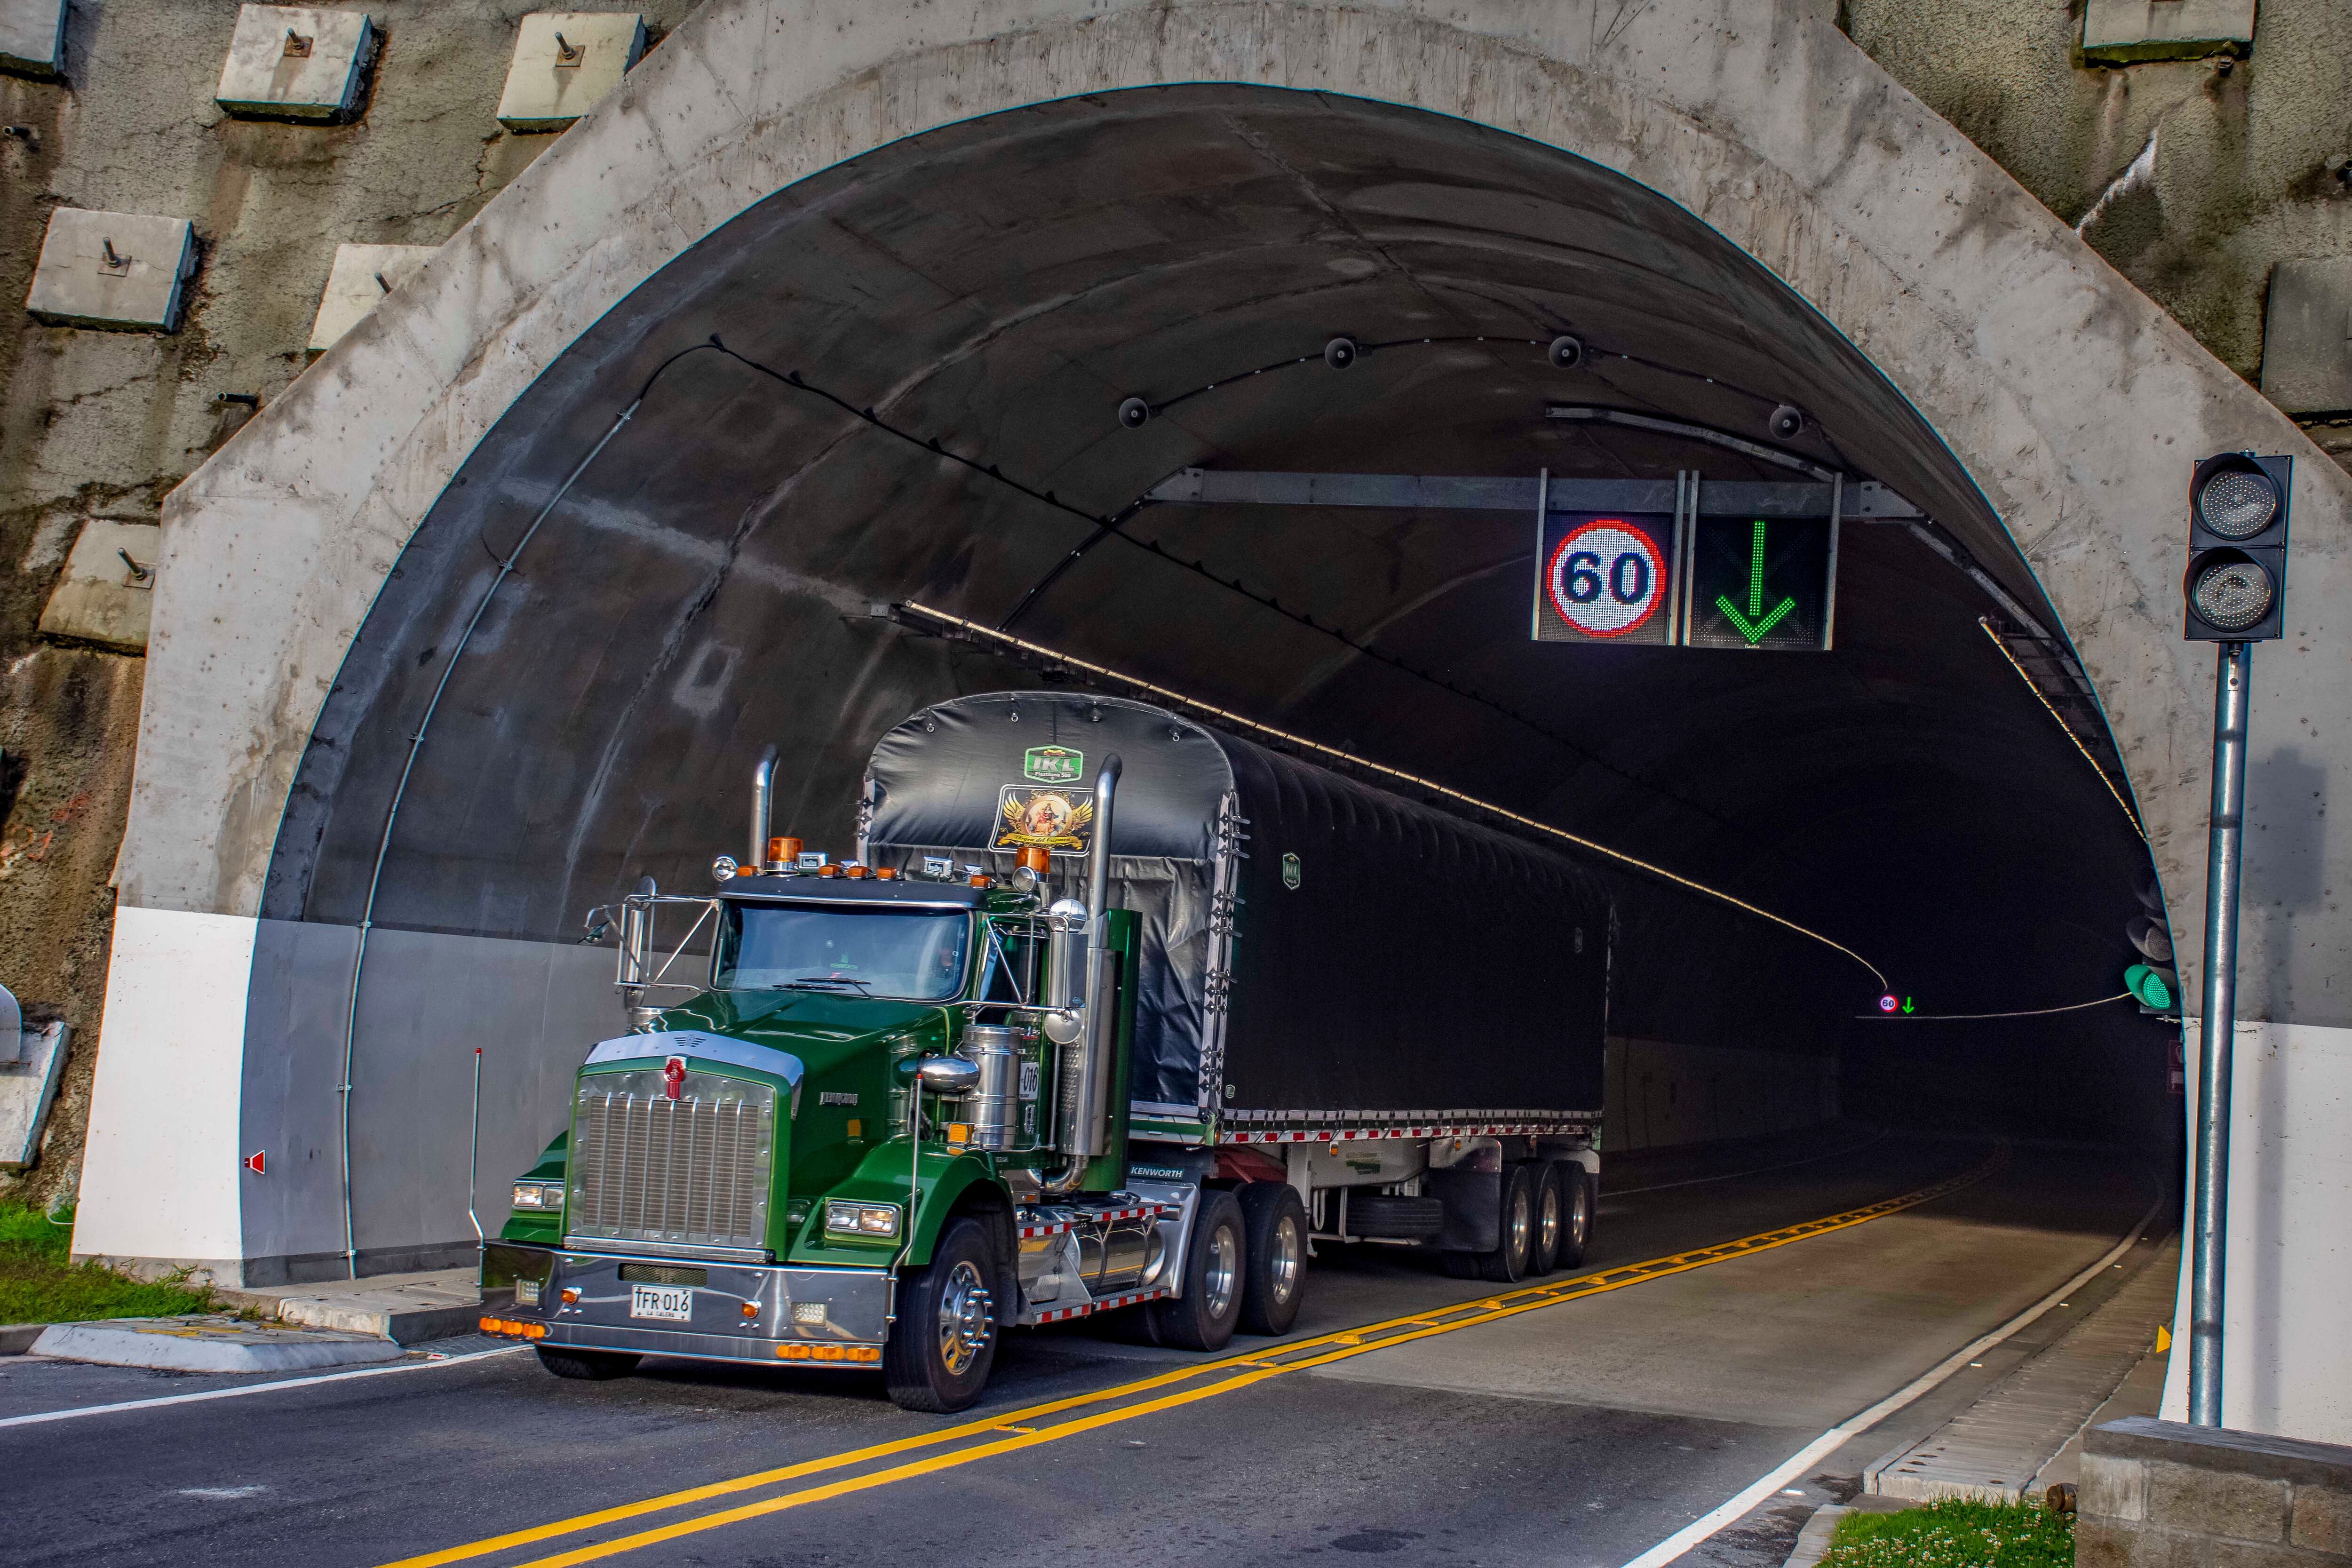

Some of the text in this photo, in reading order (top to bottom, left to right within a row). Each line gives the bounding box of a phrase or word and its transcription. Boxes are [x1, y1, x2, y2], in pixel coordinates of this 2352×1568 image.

[1561, 551, 1649, 605] 60
[1033, 757, 1074, 772] IKL
[1024, 1067, 1039, 1092] 016
[1131, 1167, 1183, 1178] KENWORTH
[636, 1291, 689, 1312] TFR 016
